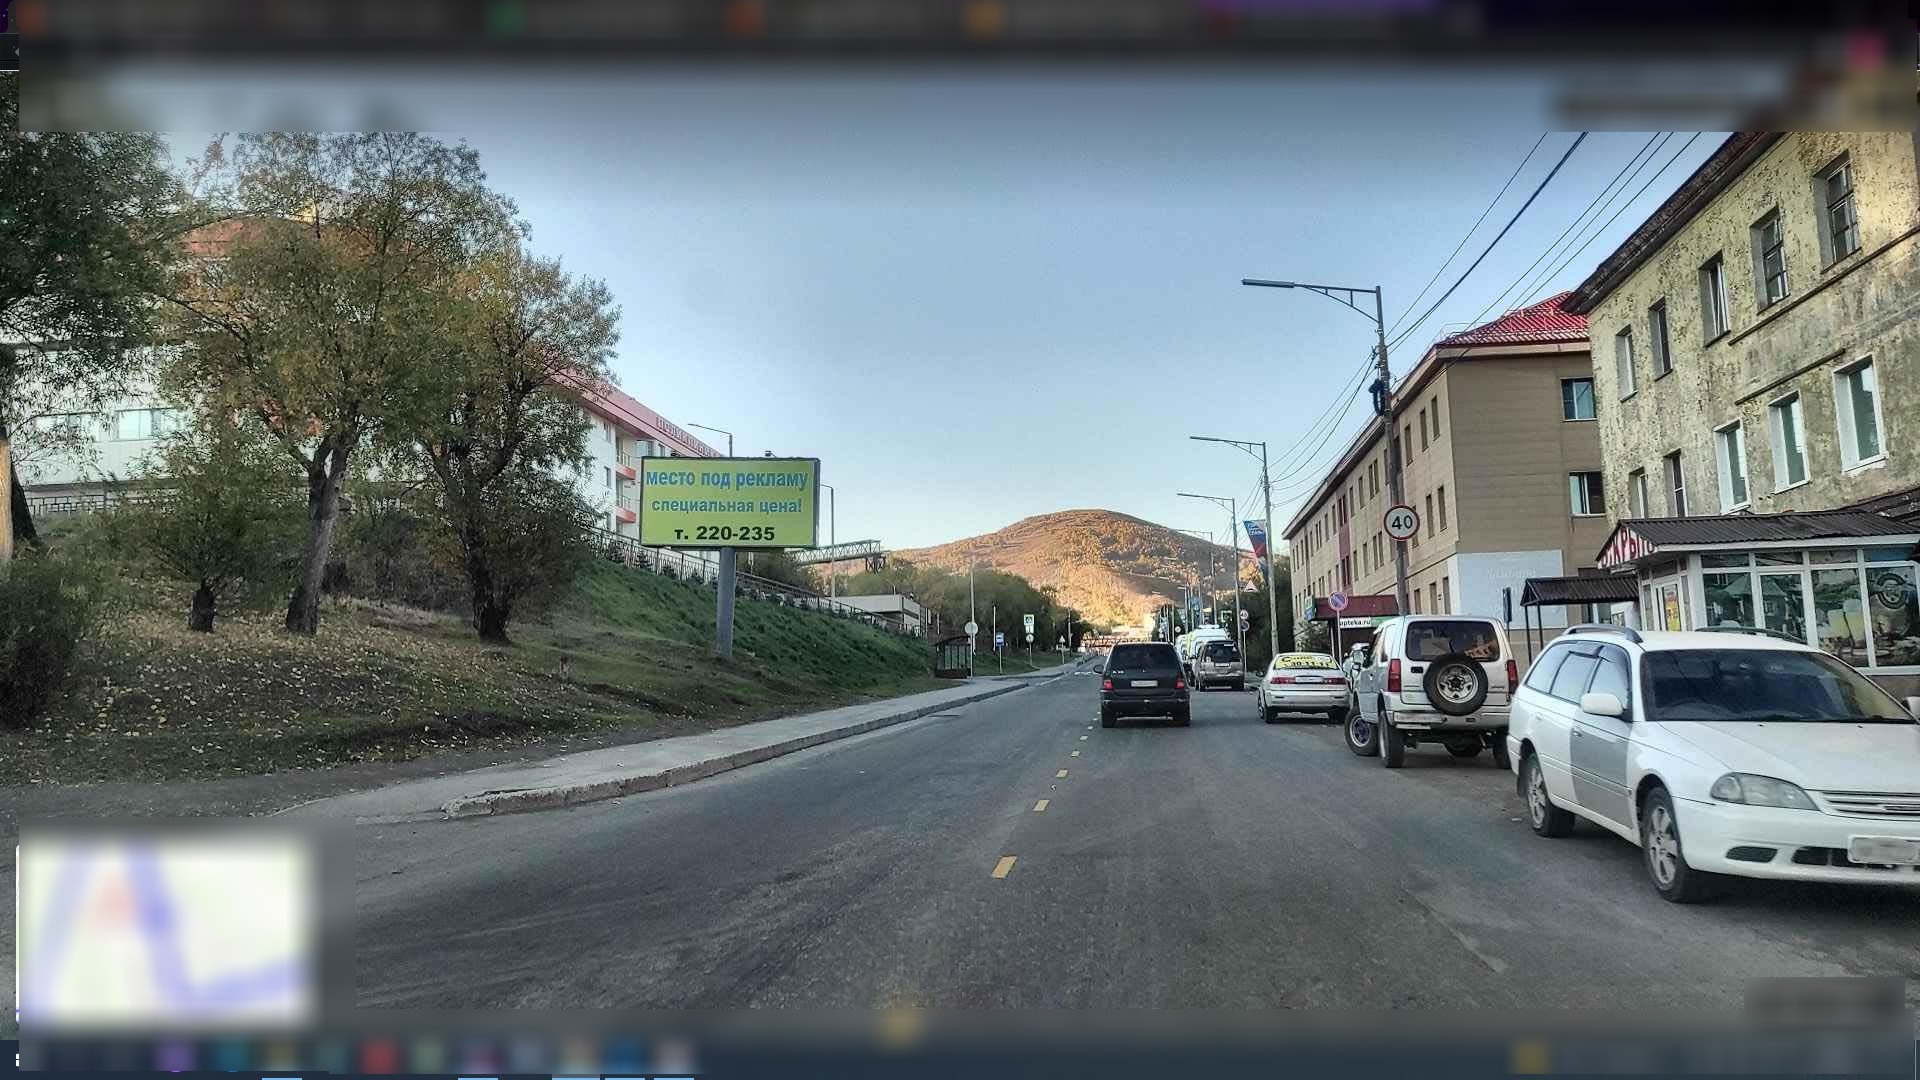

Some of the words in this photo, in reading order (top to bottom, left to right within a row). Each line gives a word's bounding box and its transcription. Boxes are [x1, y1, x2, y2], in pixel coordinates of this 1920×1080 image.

[646, 471, 695, 486] место
[701, 472, 730, 489] под
[736, 471, 808, 491] рекламу
[651, 500, 754, 514] специальная
[759, 499, 802, 515] цена!
[1391, 514, 1413, 529] 40
[674, 529, 689, 540] т.
[696, 526, 775, 541] 220-235
